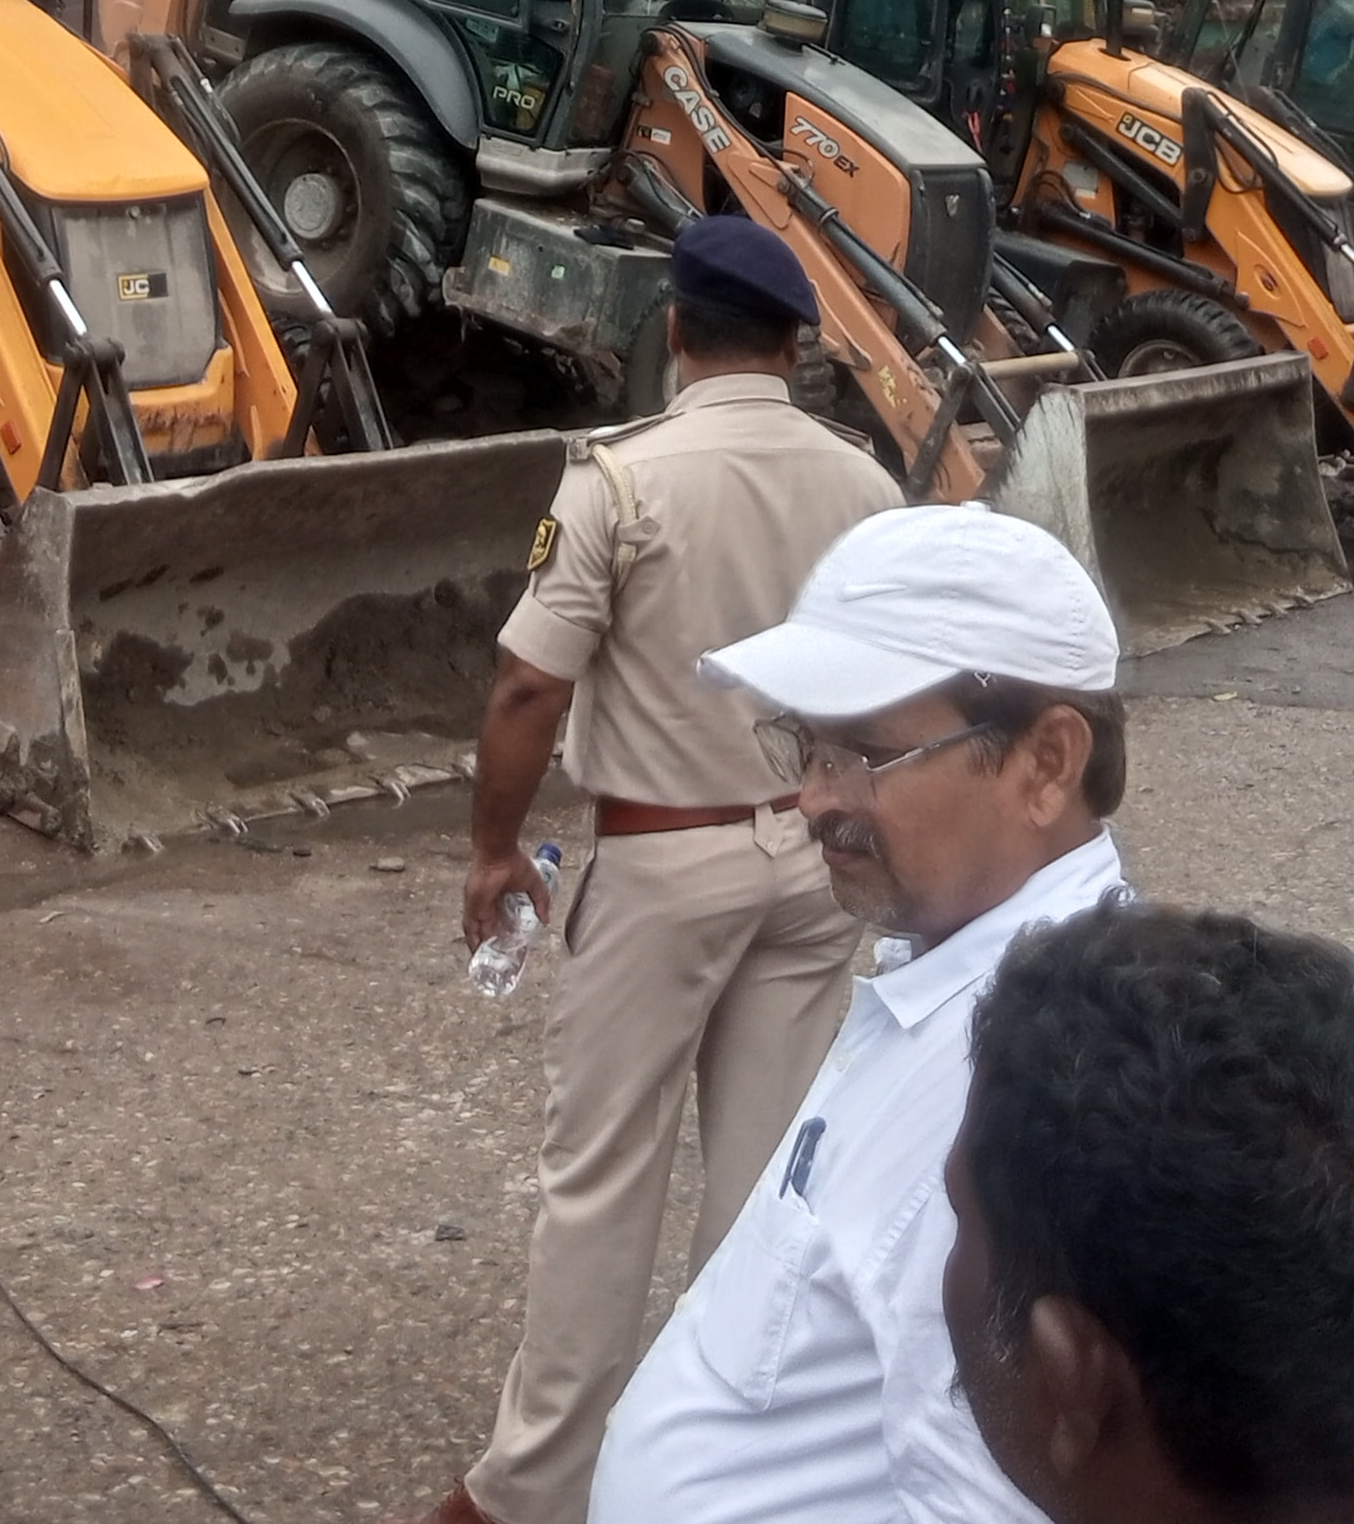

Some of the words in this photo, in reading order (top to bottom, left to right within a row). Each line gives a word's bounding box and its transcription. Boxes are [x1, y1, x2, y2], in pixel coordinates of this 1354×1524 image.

[493, 85, 535, 110] PRO
[664, 66, 731, 154] CASE
[1118, 114, 1182, 166] JCB
